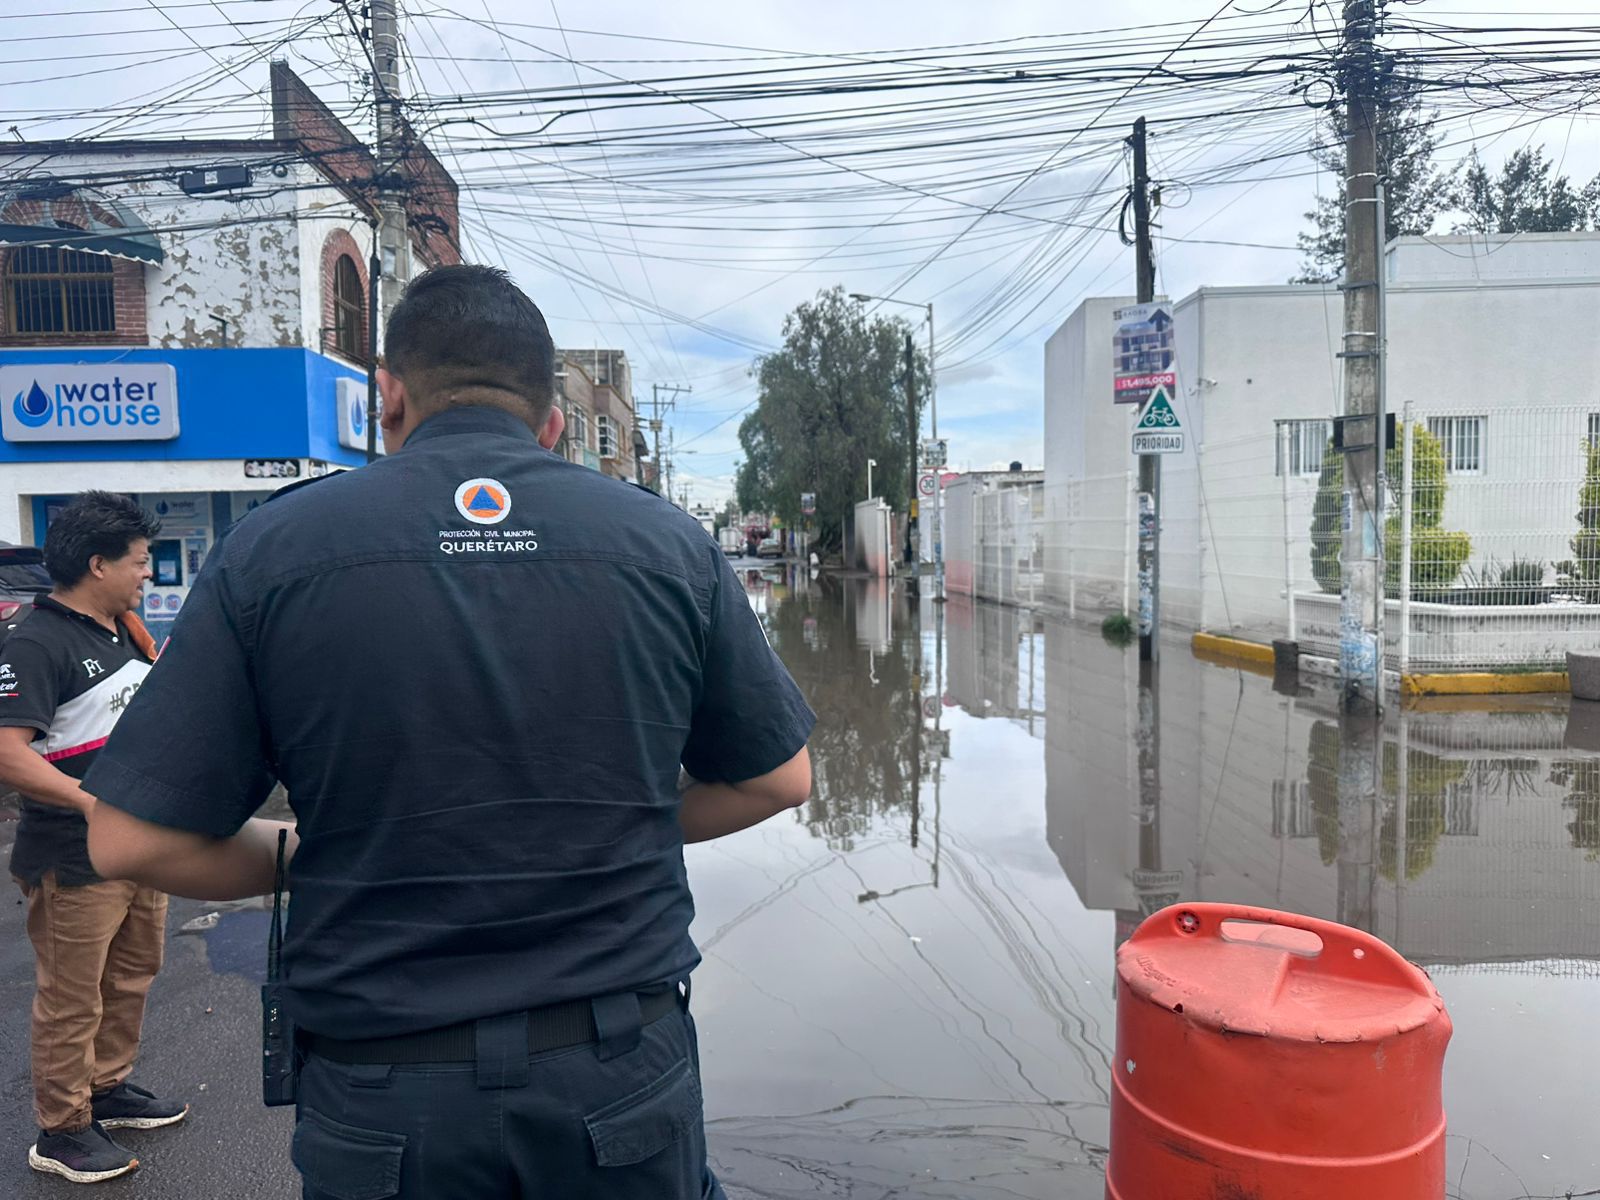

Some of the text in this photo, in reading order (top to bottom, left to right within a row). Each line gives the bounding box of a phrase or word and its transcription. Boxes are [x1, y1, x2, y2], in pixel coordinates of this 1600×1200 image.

[62, 376, 157, 402] water
[55, 384, 161, 426] house
[1135, 437, 1181, 450] PRIORIDAD
[923, 479, 935, 488] 30
[439, 529, 481, 537] PROTECCIÓN
[440, 539, 538, 554] QUERÉTARO
